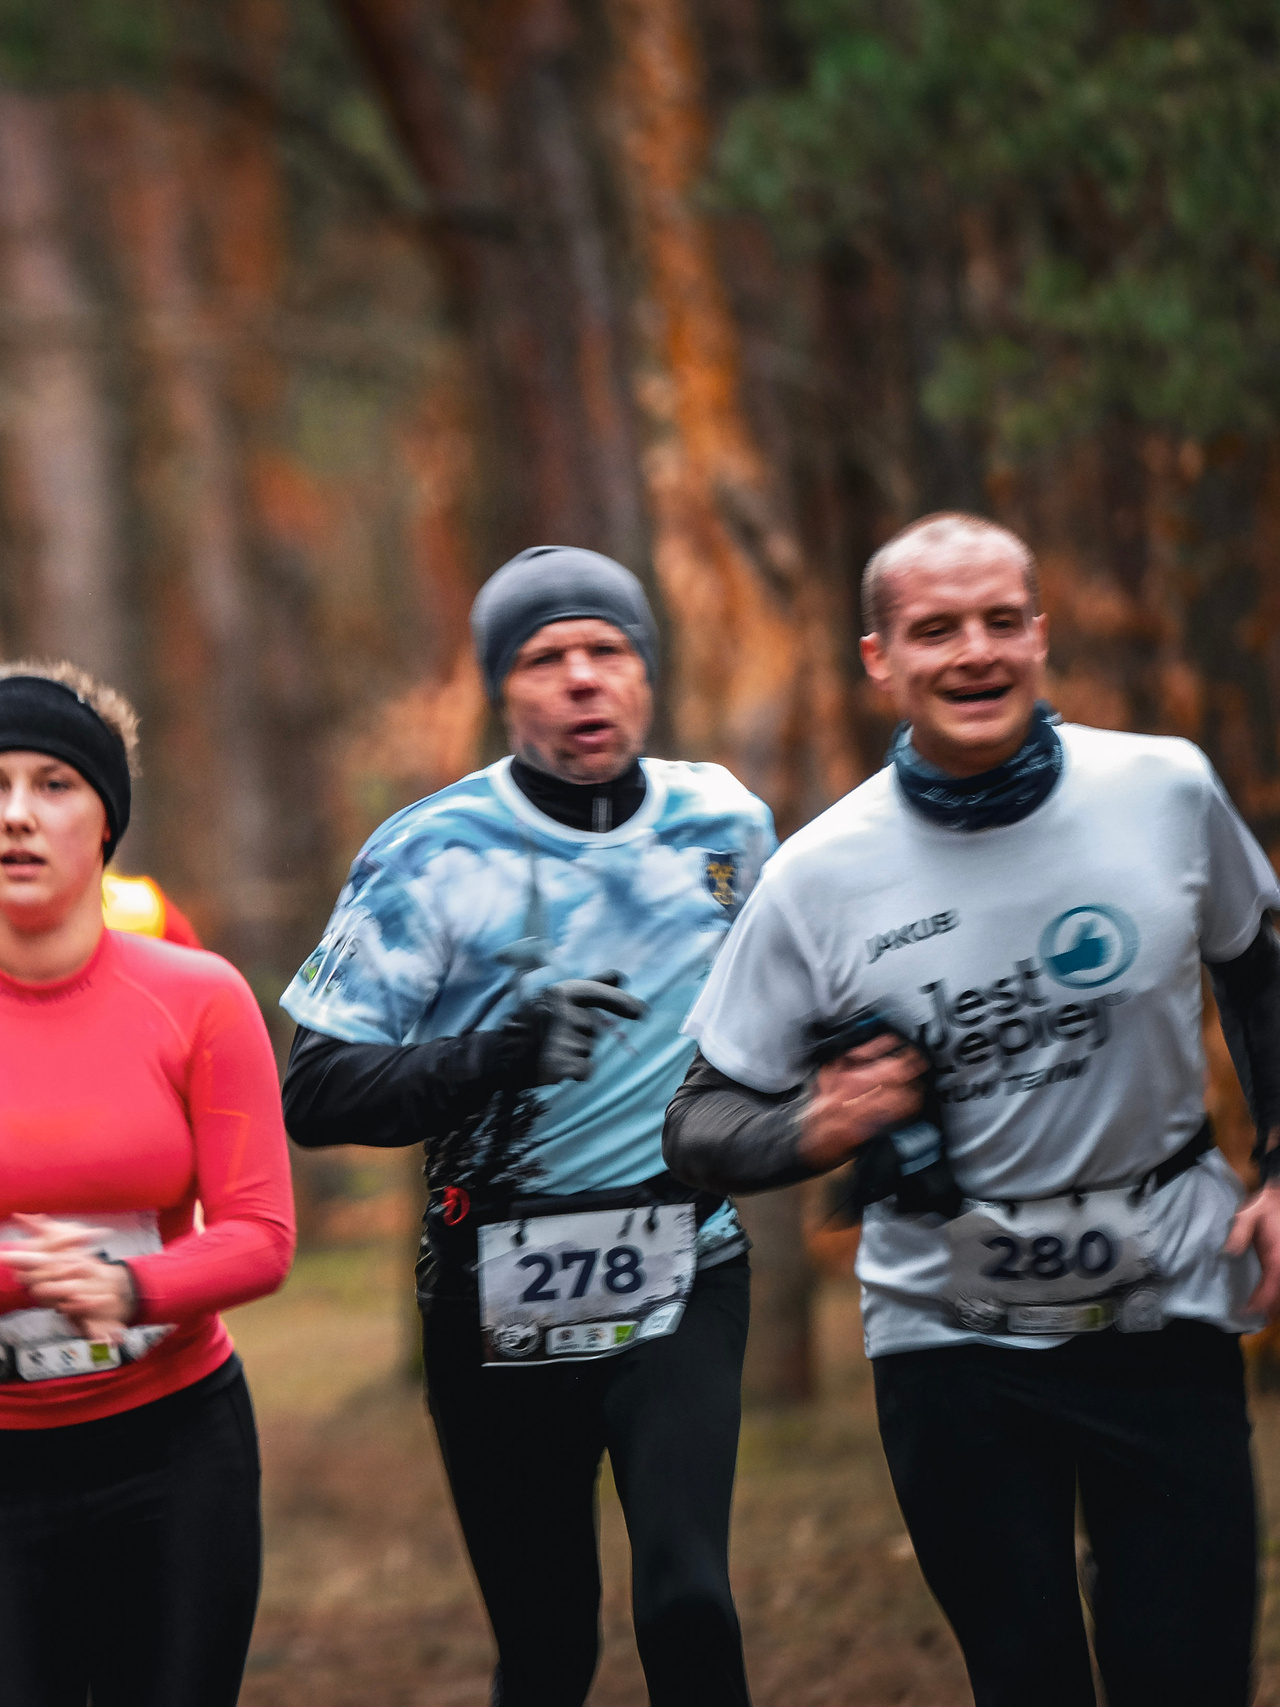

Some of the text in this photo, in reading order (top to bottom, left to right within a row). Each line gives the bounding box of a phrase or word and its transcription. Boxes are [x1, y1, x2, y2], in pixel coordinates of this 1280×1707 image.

[866, 908, 960, 965] JAKUB
[918, 956, 1047, 1048] Jest
[929, 1001, 1111, 1075] epiej
[516, 1244, 645, 1303] 278
[981, 1229, 1116, 1281] 280
